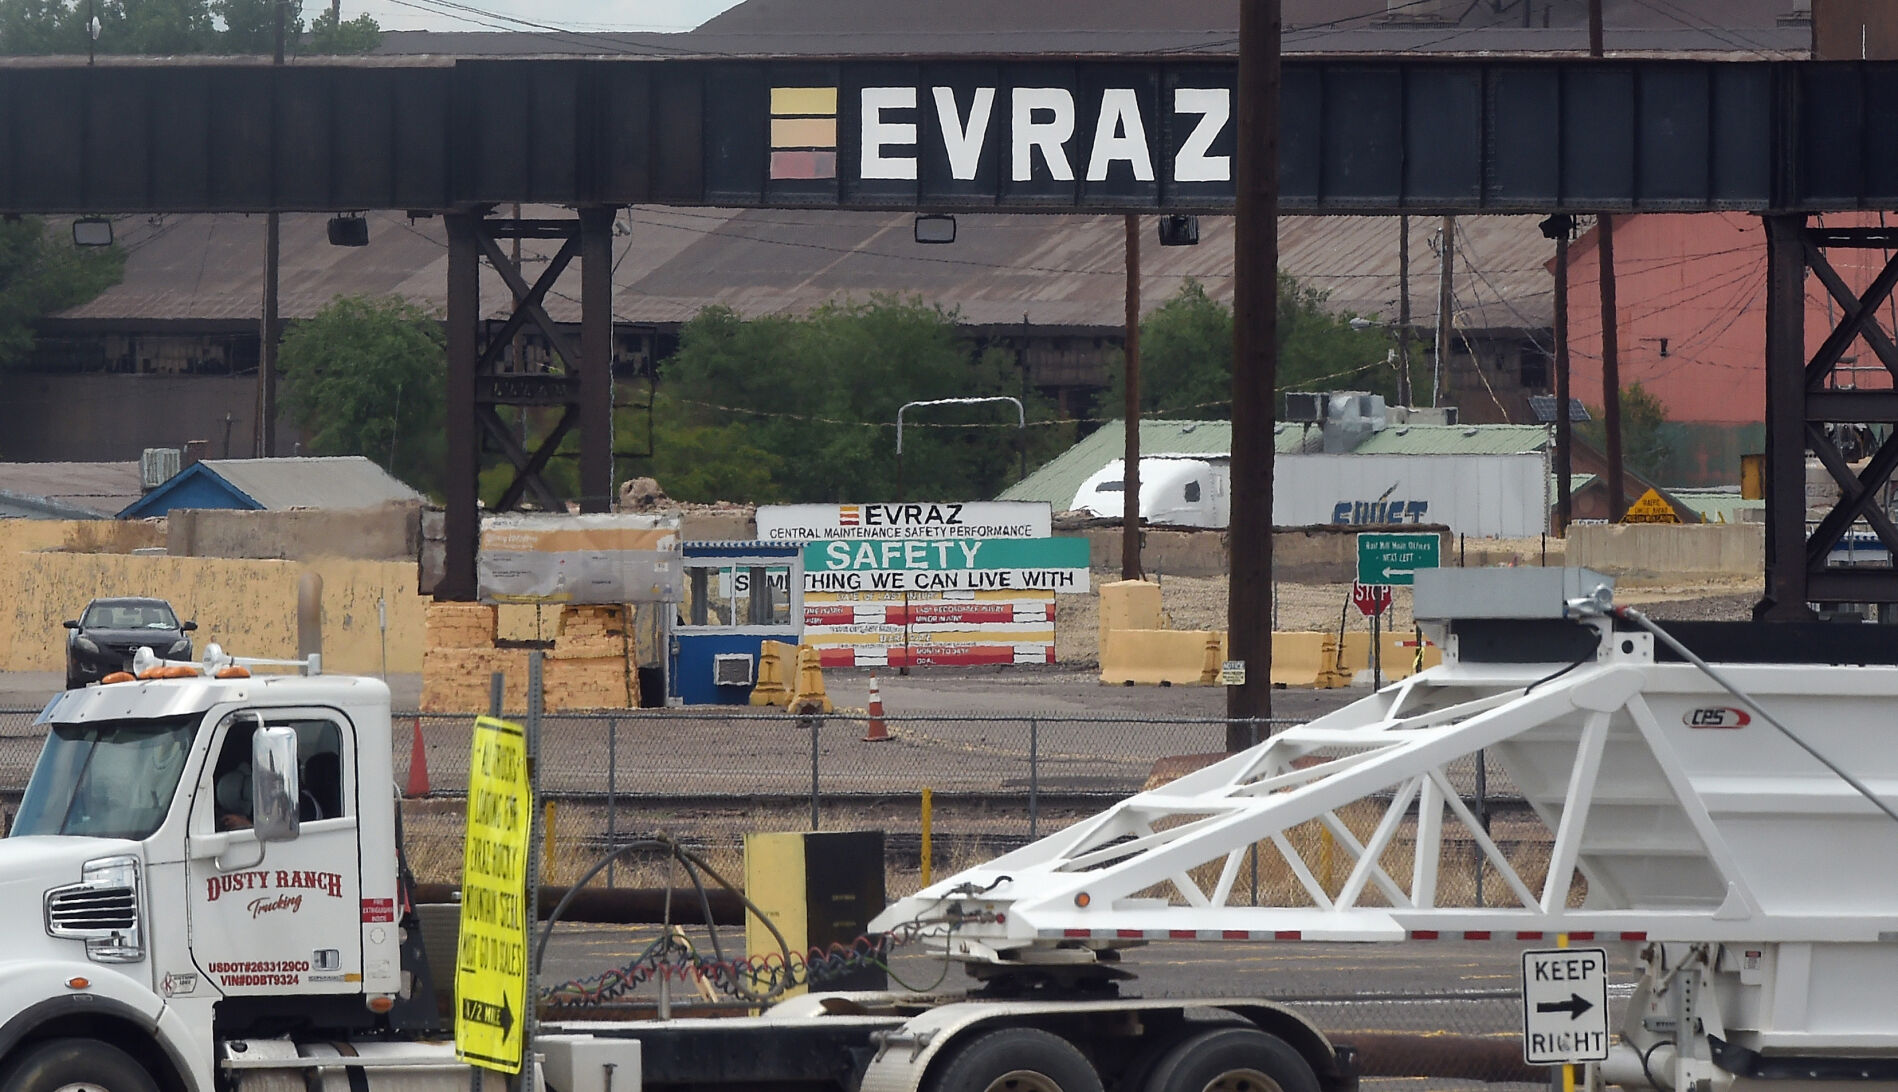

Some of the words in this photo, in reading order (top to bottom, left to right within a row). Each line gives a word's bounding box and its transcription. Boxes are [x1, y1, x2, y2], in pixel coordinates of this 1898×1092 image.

[861, 87, 1230, 181] EVRAZ
[866, 505, 962, 525] EVRAZ
[770, 528, 820, 539] CENTRAL
[824, 527, 901, 538] MAINTENANCE
[905, 526, 950, 537] SAFETY
[950, 525, 1032, 537] PERFORMANCE
[826, 541, 982, 570] SAFETY
[871, 572, 904, 589] WE
[915, 572, 958, 589] CAN
[968, 572, 1011, 587] LIVE
[1022, 571, 1073, 587] WITH
[207, 870, 270, 902] DUSTY
[275, 870, 343, 898] RANCH
[247, 893, 303, 919] Trucking
[208, 961, 310, 973] USDOT#2633129CO
[1535, 960, 1595, 981] KEEP
[220, 974, 299, 986] VIN#DDBT9324
[1532, 1032, 1604, 1053] RIGHT
